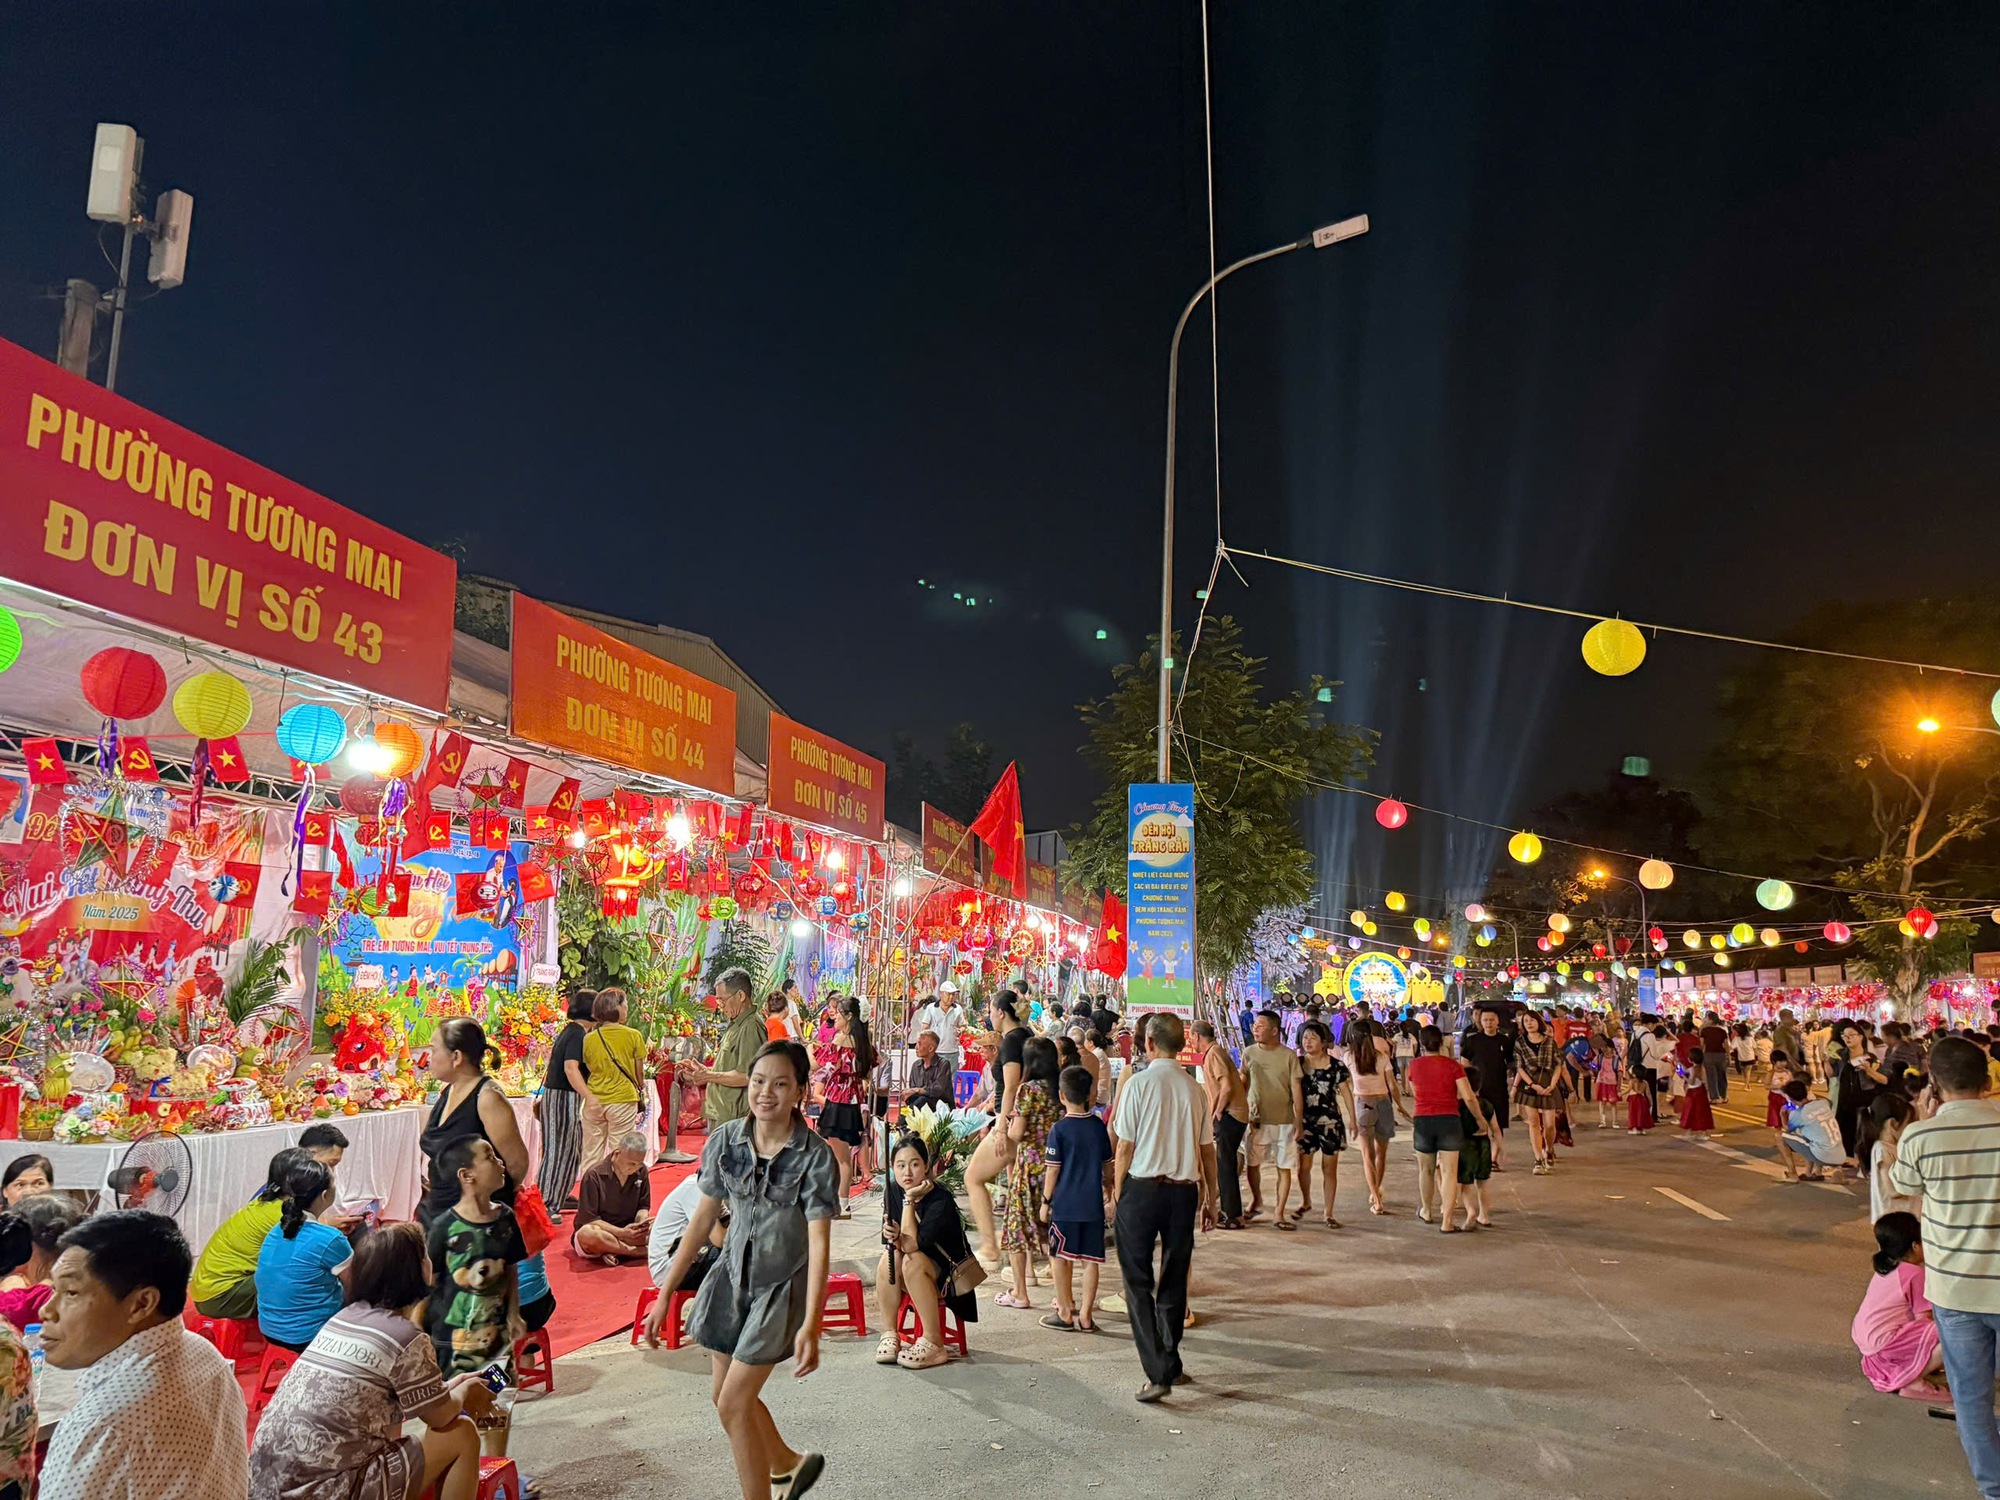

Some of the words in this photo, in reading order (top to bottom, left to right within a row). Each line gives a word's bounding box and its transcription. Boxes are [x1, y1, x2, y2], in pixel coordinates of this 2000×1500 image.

[26, 393, 213, 521] PHƯỜNG
[226, 482, 337, 574] TƯƠNG
[345, 538, 402, 601] MAI
[44, 500, 177, 596] ĐƠN
[196, 556, 243, 629] VỊ
[259, 583, 325, 643] SỐ
[333, 612, 383, 665] 43
[557, 634, 630, 694] PHƯỜNG
[634, 667, 683, 717] TƯƠNG
[686, 689, 712, 726] MAI
[566, 696, 619, 743] ĐƠN
[650, 723, 678, 761] SỐ
[682, 739, 705, 770] 44
[790, 736, 829, 773] PHƯỜNG
[830, 752, 857, 785] TƯƠNG
[857, 764, 872, 791] MAI
[794, 779, 821, 809] ĐƠN
[824, 789, 836, 819] VỊ
[838, 791, 853, 820] SỐ
[855, 801, 868, 824] 45
[26, 811, 58, 842] Đê
[1132, 837, 1167, 853] TRĂNG
[1160, 822, 1176, 839] HỘI
[4, 871, 62, 917] Vui
[171, 883, 206, 930] Thu
[82, 901, 107, 919] Năm
[109, 905, 141, 921] 2025
[361, 935, 376, 951] TRẺ
[377, 939, 390, 951] EM
[391, 938, 416, 952] TƯƠNG
[416, 939, 433, 954] MAI,
[434, 939, 446, 953] VUI
[447, 937, 459, 953] TẾT
[460, 939, 480, 953] TRUNG
[1177, 1006, 1190, 1015] MAI
